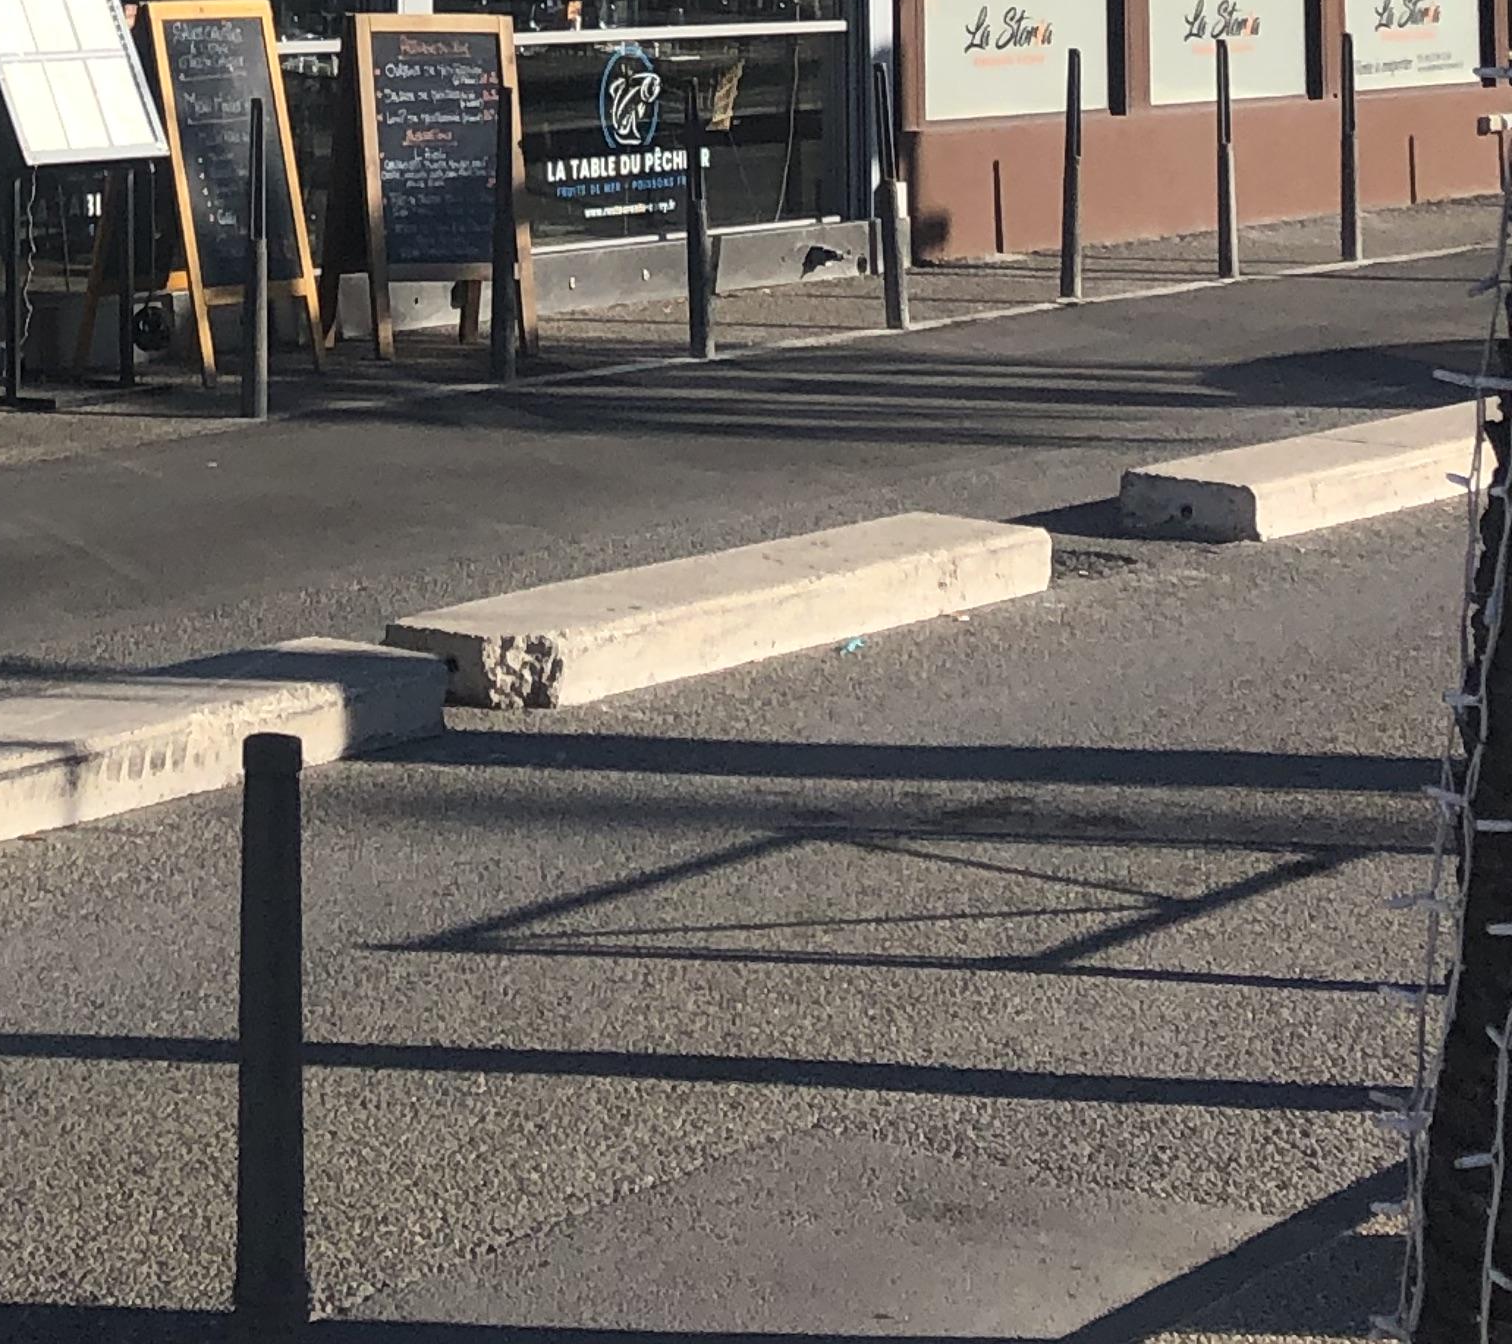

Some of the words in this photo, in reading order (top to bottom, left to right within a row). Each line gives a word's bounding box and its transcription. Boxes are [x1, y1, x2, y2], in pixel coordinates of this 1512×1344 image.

[964, 5, 990, 53] La
[995, 6, 1053, 50] Storia
[1210, 0, 1261, 40] Storia
[546, 161, 567, 183] LA
[569, 155, 616, 181] TABLE
[619, 152, 642, 176] DU
[644, 146, 711, 174] PÊCHR
